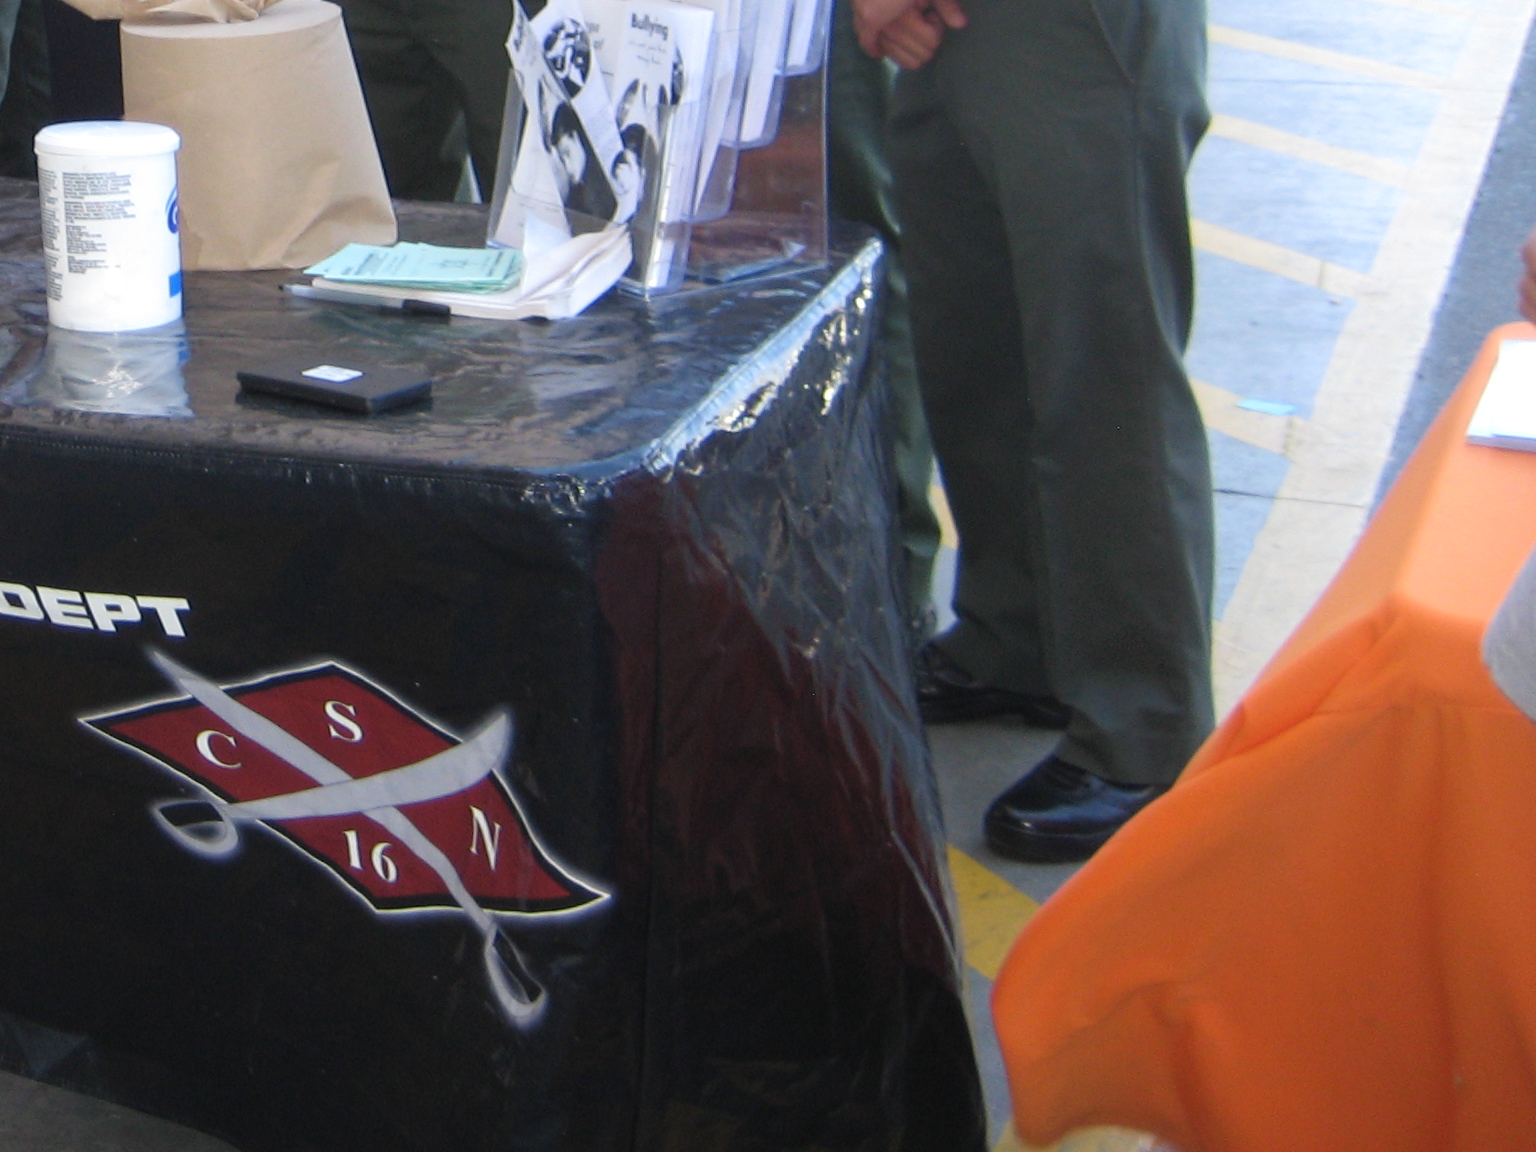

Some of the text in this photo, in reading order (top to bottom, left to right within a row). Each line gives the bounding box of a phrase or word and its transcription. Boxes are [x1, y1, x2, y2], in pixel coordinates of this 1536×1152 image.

[630, 12, 669, 42] Bullying
[323, 699, 365, 743] S
[196, 729, 242, 771] C
[342, 828, 399, 884] 16
[468, 804, 502, 872] N
